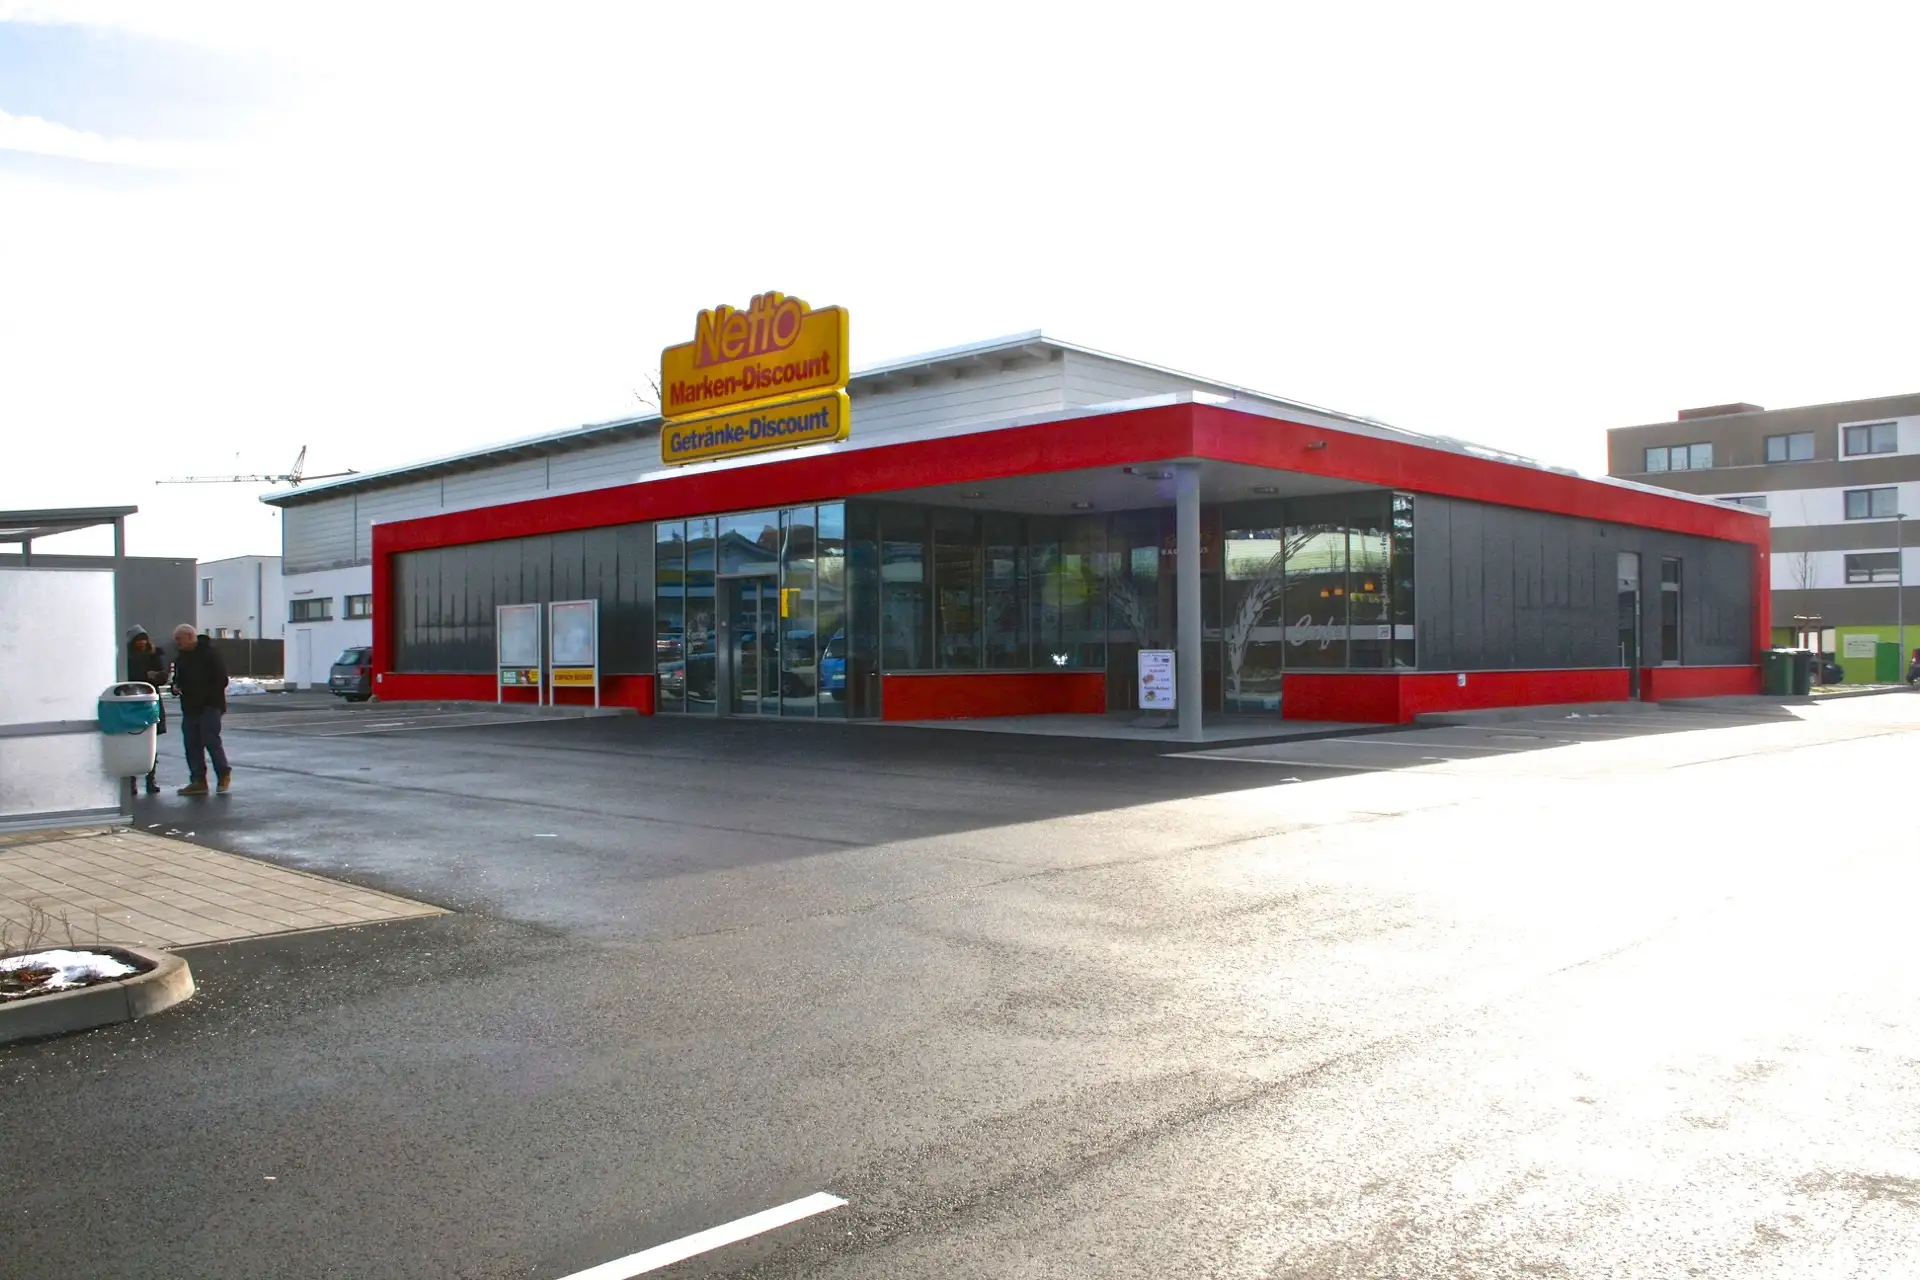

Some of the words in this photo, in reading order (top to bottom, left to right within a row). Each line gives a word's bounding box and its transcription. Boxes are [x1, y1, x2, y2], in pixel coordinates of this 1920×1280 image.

[696, 293, 803, 366] Netto
[670, 350, 830, 406] Marken-Discount
[670, 406, 829, 452] Getränke-Discount
